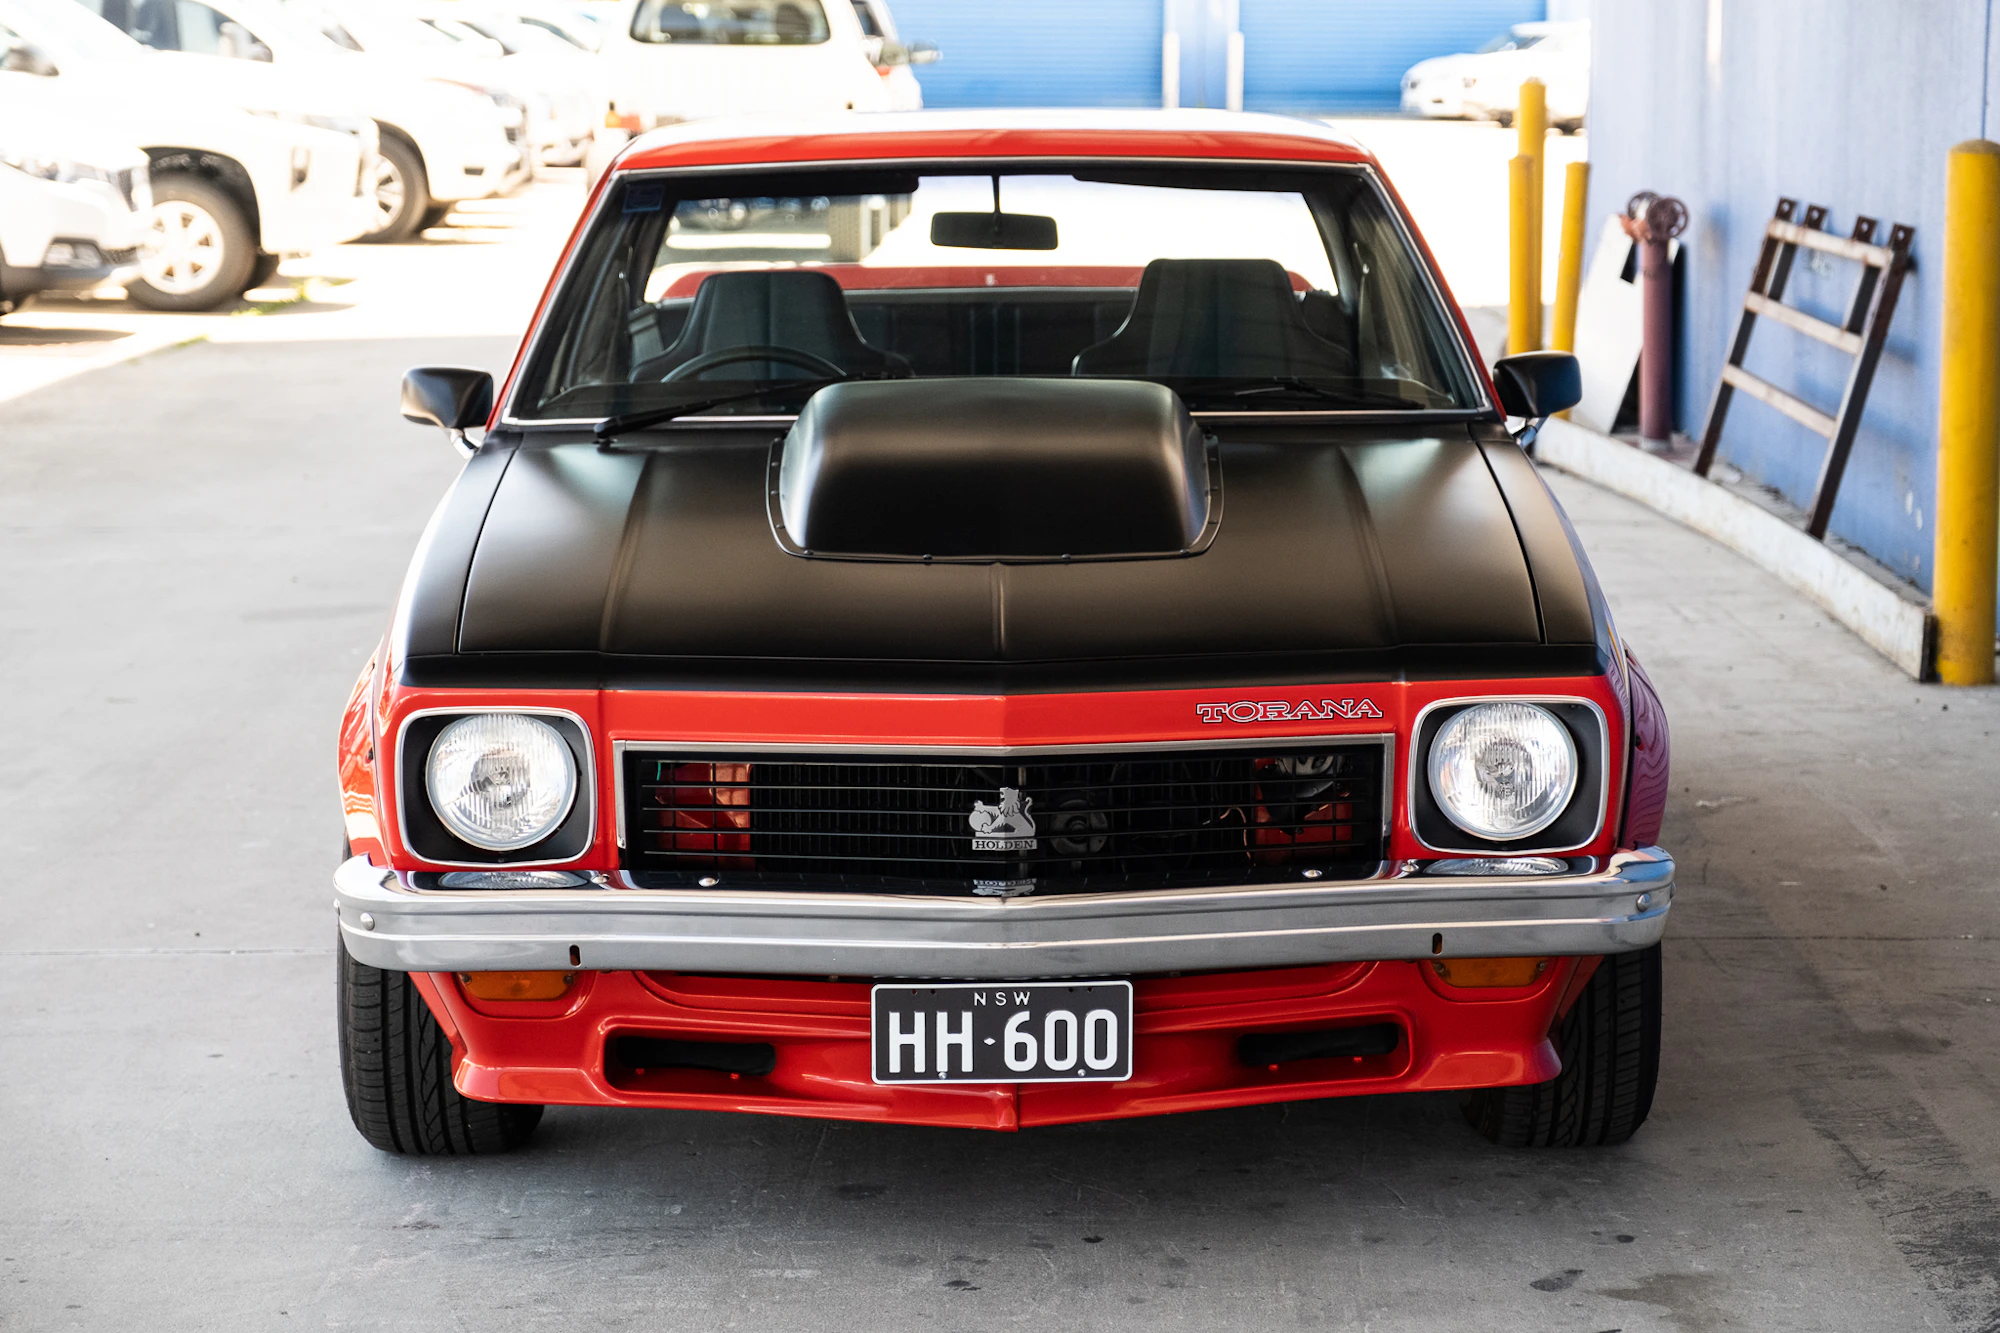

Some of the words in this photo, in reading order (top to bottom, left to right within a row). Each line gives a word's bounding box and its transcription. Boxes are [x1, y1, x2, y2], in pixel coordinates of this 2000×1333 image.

[1196, 699, 1384, 723] TORANA
[975, 840, 1033, 850] HOLDEN
[973, 991, 1031, 1006] NSW
